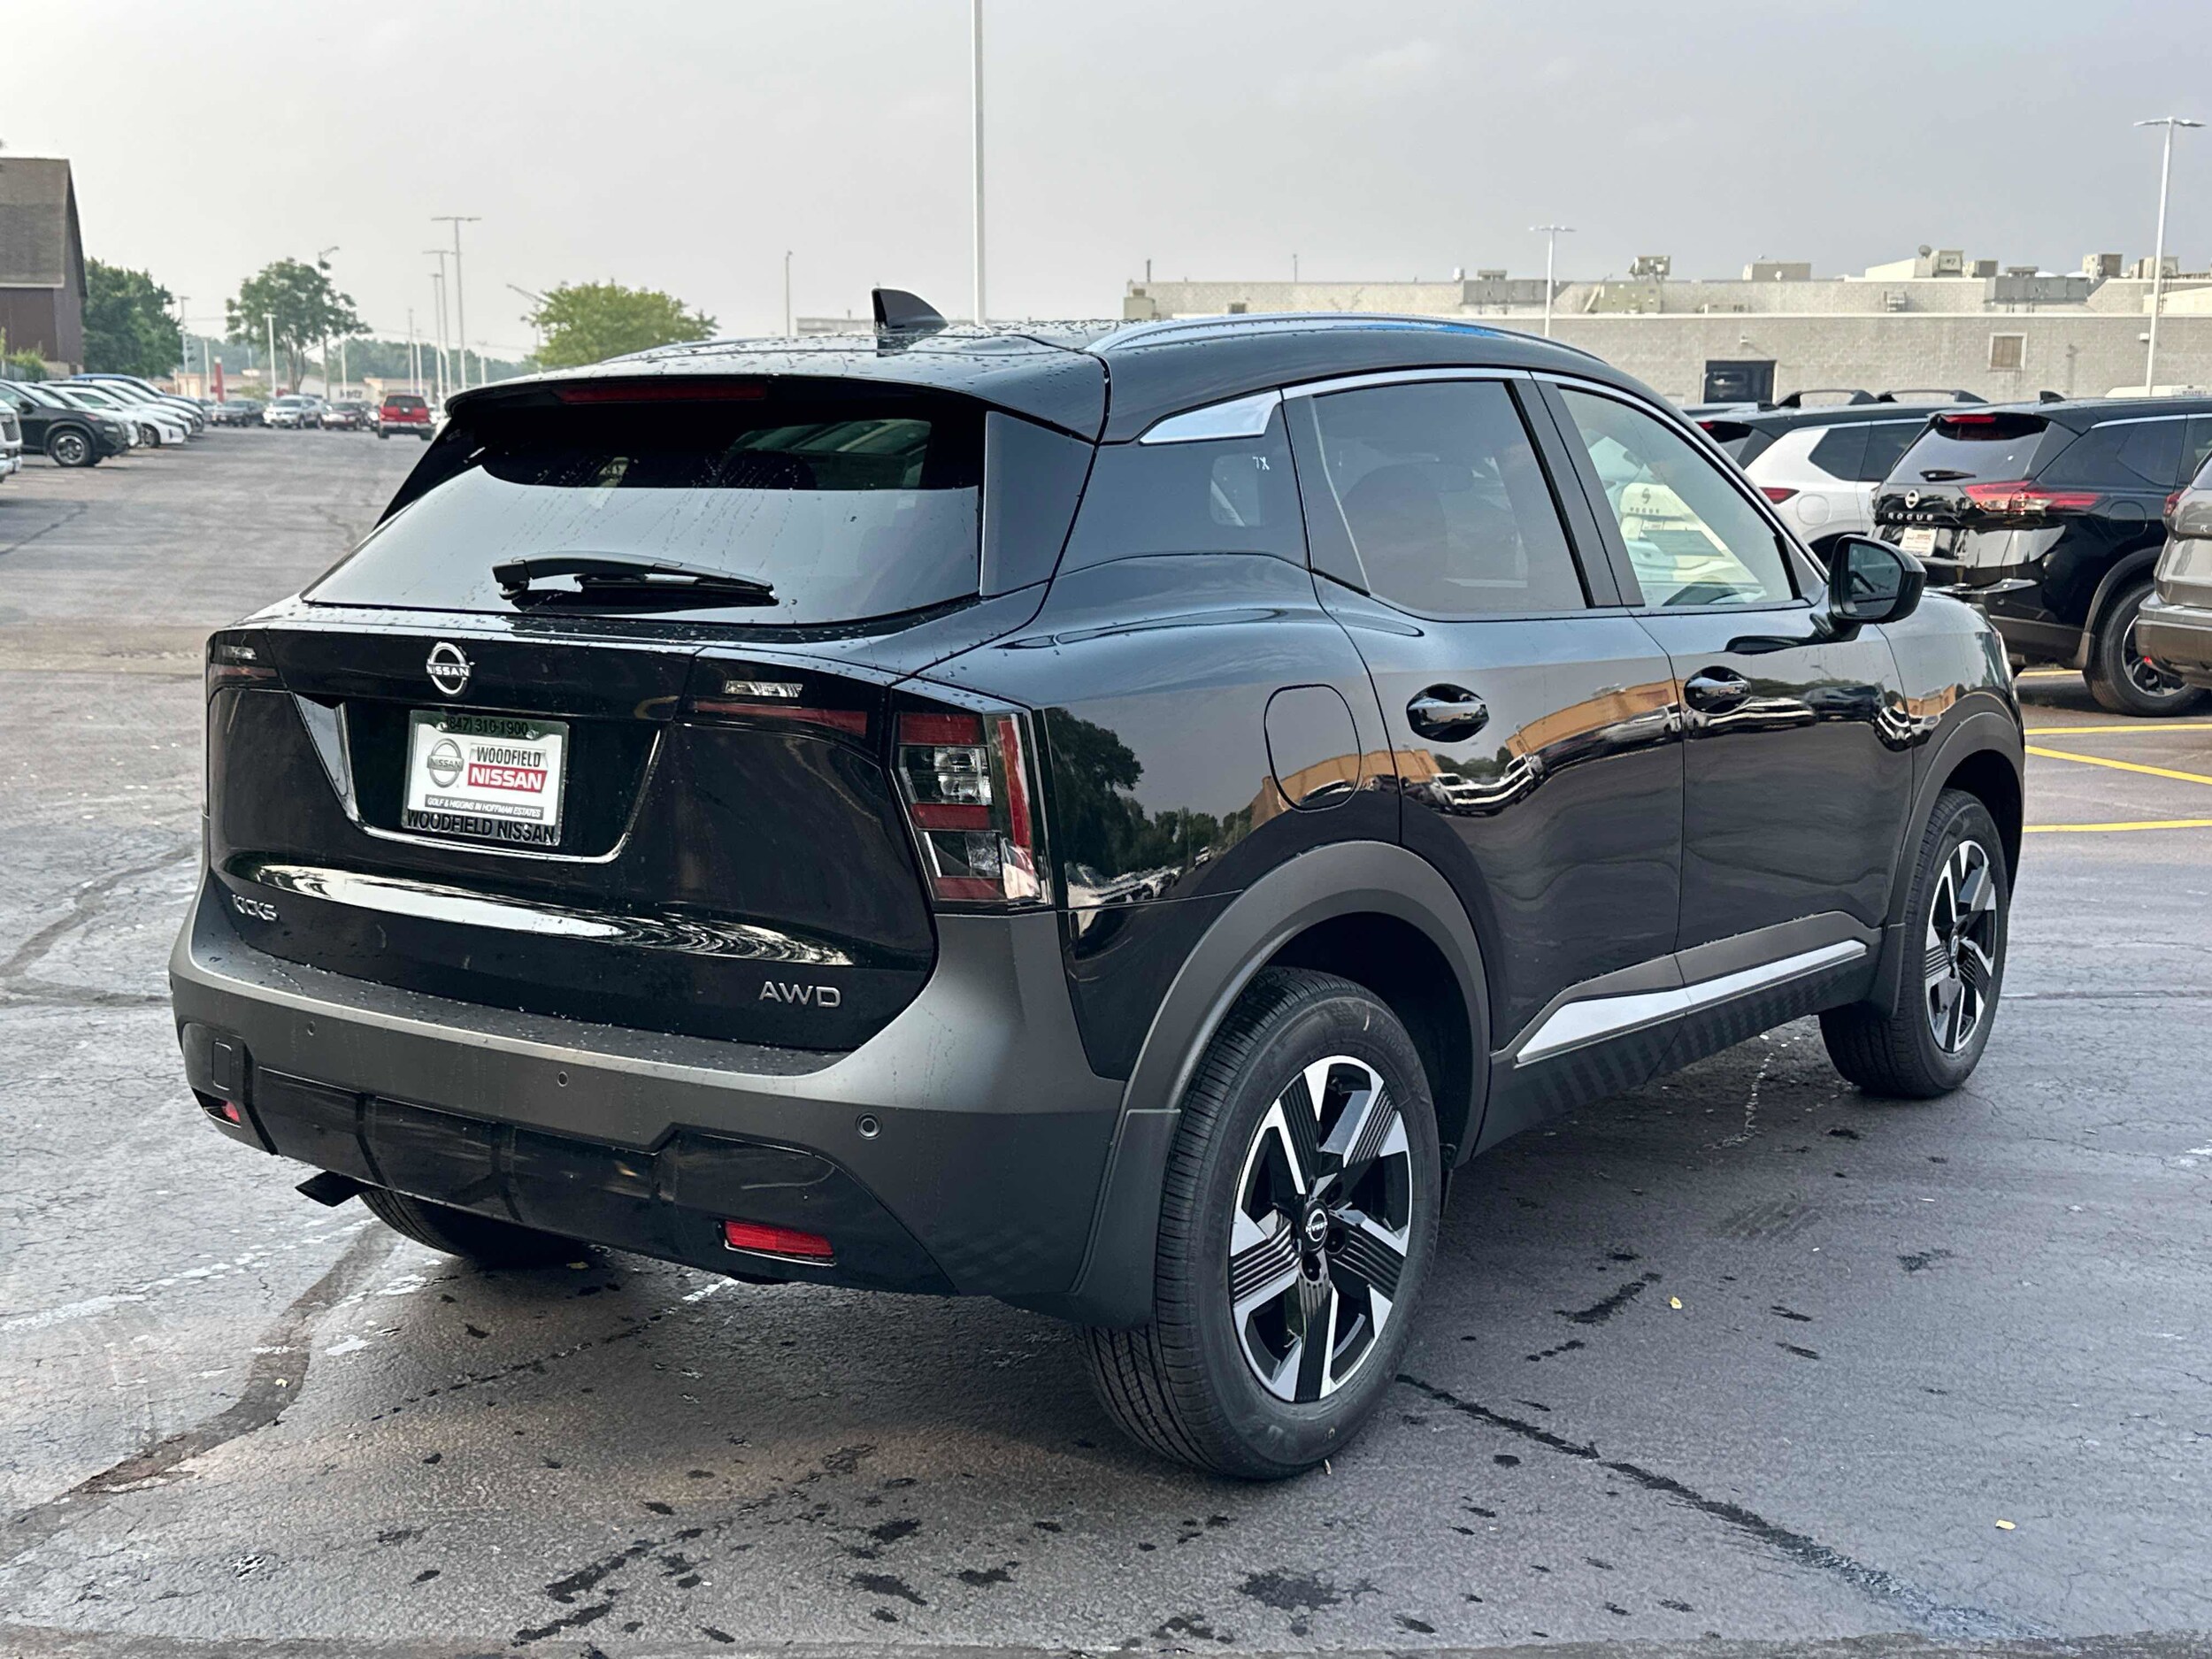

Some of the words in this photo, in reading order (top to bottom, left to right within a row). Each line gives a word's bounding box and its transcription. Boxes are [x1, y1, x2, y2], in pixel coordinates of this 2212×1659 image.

[1887, 512, 1933, 521] ROGUE
[426, 664, 471, 677] NISSAN
[475, 718, 529, 735] 310-1900
[430, 757, 462, 768] NISSAN
[477, 746, 541, 767] WOODFIELD
[471, 766, 542, 790] NISSAN
[427, 797, 444, 807] GOLF
[449, 800, 474, 810] HIGGINS
[475, 803, 482, 811] IN
[482, 803, 513, 814] HOFFMAN
[513, 807, 541, 818] ESTATES
[407, 809, 493, 835] WOODFIELD
[497, 822, 555, 844] NISSAN
[758, 980, 841, 1008] AWD
